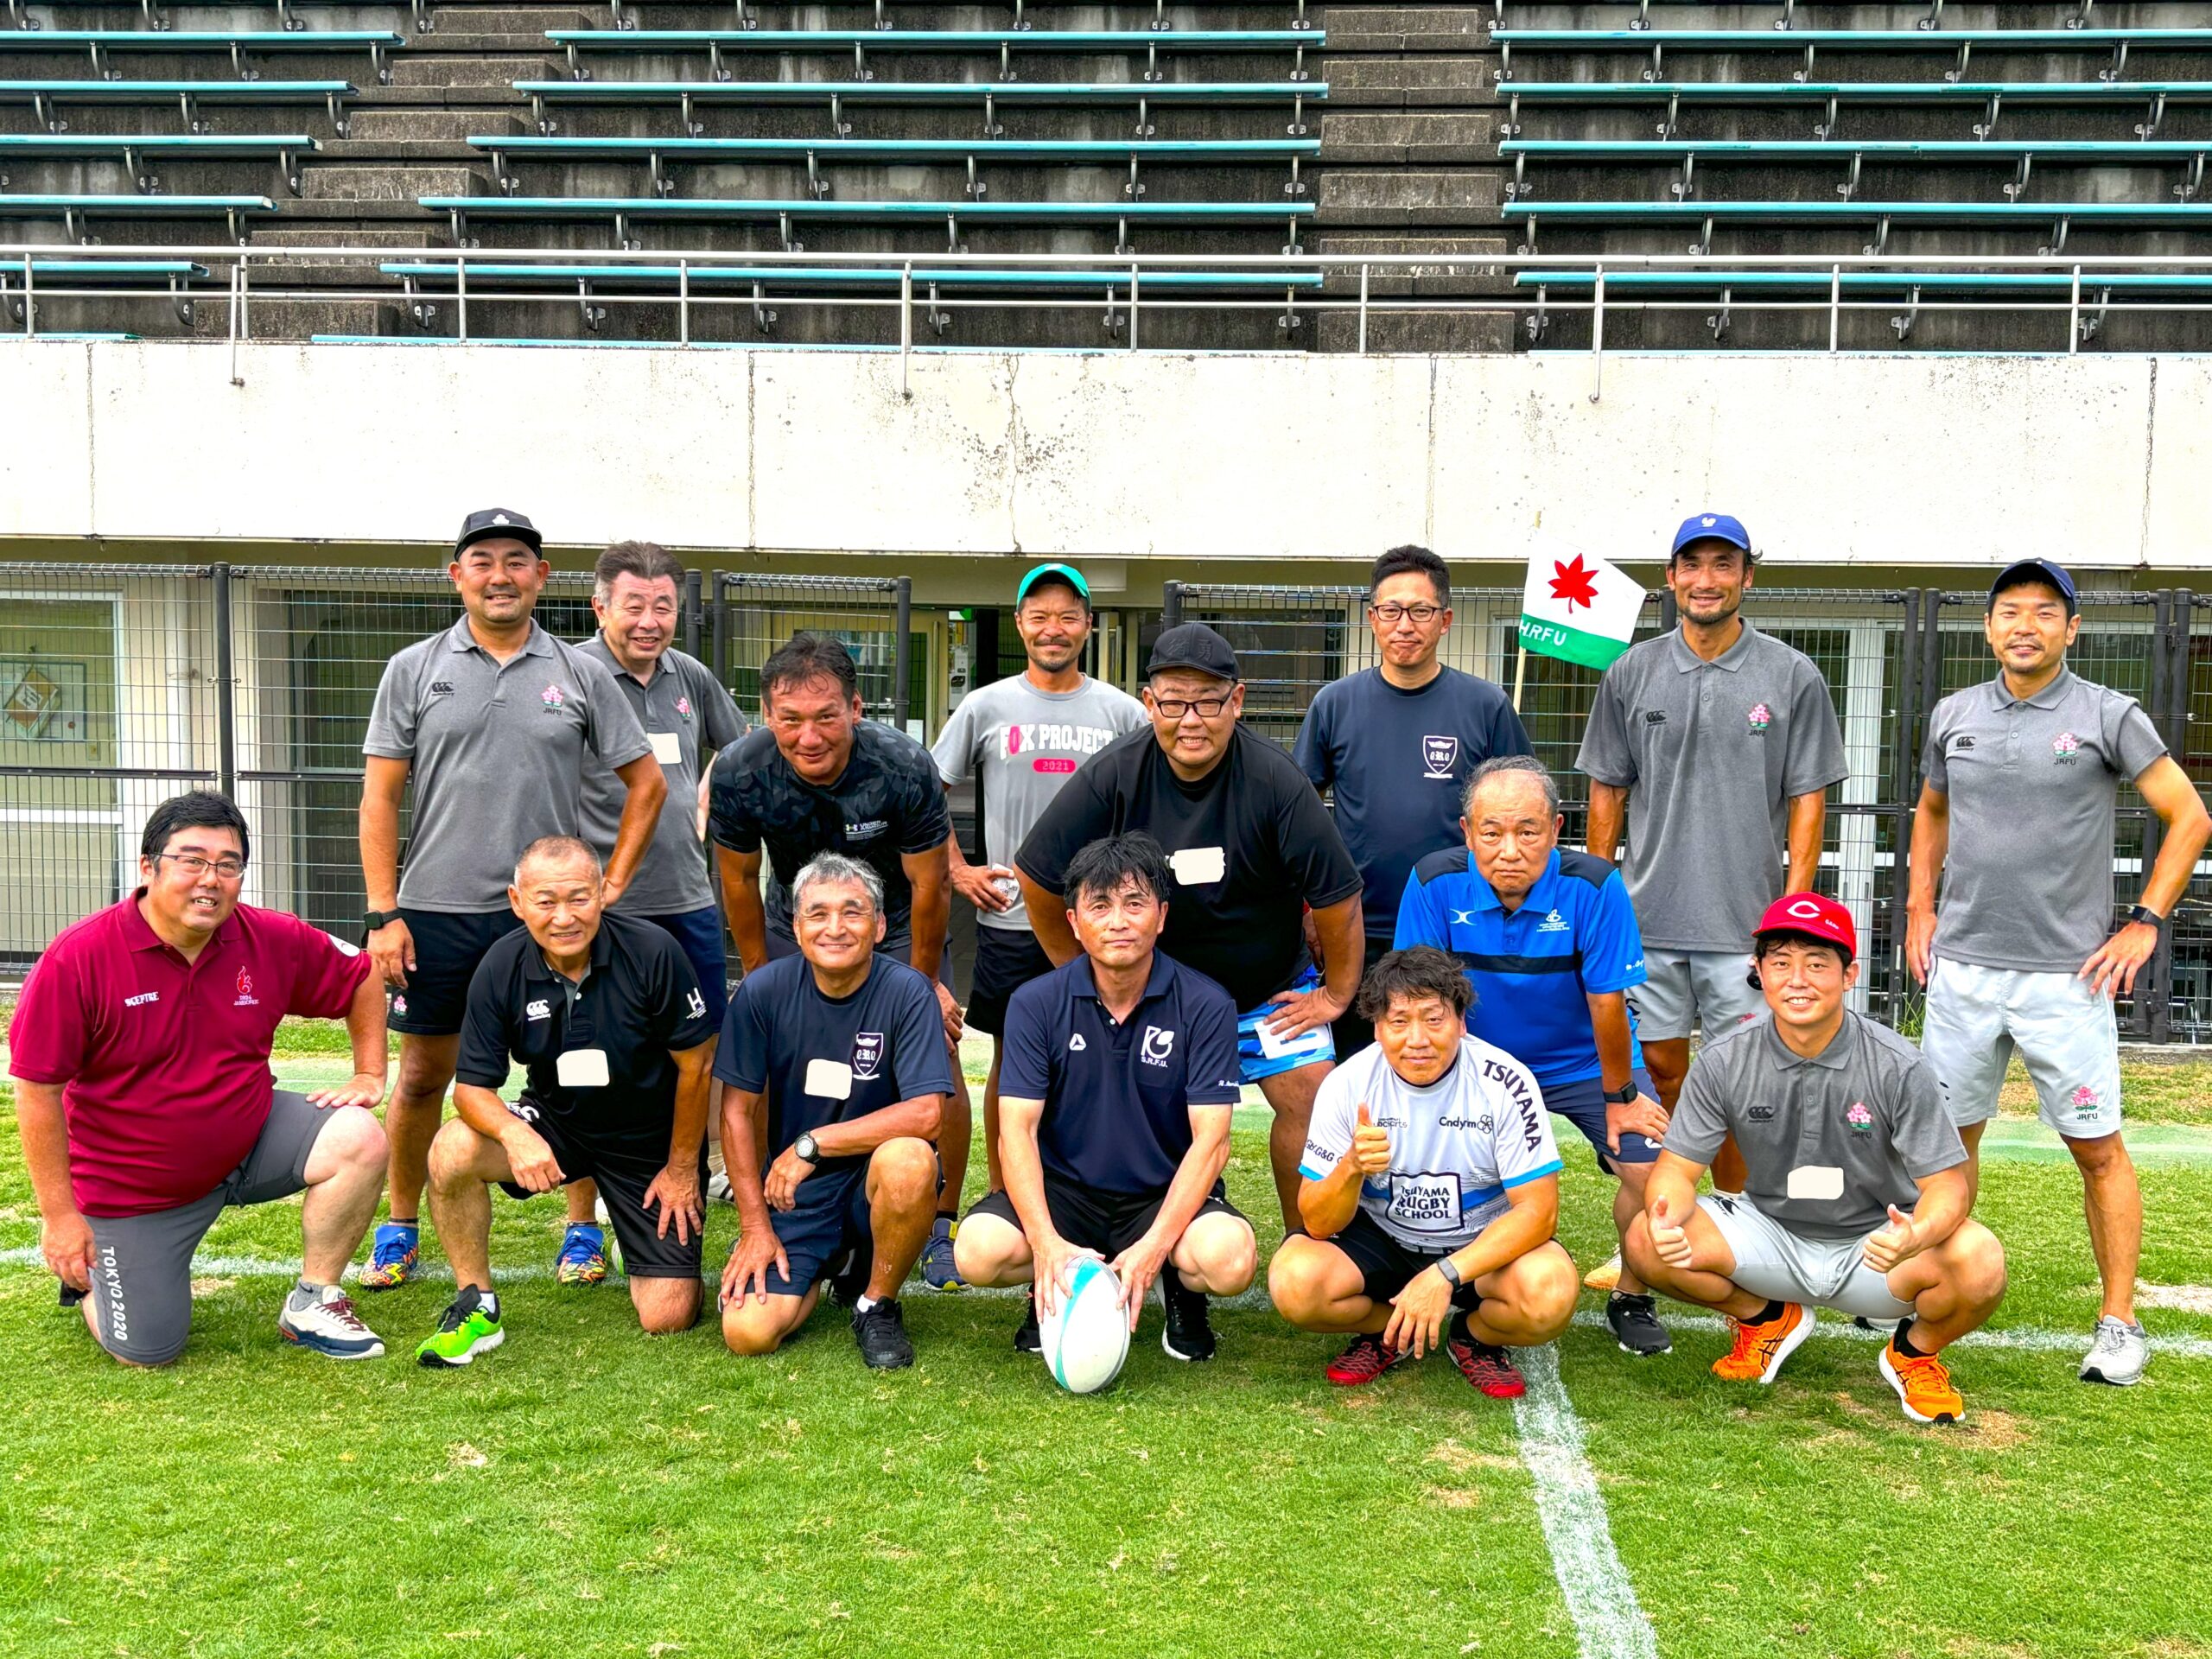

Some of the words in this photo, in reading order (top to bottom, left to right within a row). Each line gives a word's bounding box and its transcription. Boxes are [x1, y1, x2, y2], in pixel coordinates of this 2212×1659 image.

[1000, 724, 1035, 760] FOX
[1039, 724, 1114, 755] PROJECT
[1042, 761, 1069, 771] 2021
[124, 991, 160, 1007] SCEPTRE
[1141, 1056, 1168, 1068] S.R.F.U.
[1483, 1059, 1541, 1153] TSUYAMA
[2076, 1112, 2098, 1121] JRFU
[1401, 1185, 1450, 1198] TSUYAMA
[1396, 1196, 1450, 1210] RUGBY
[1394, 1207, 1452, 1219] SCHOOL
[102, 1246, 124, 1299] TOKYO
[111, 1300, 129, 1341] 2020
